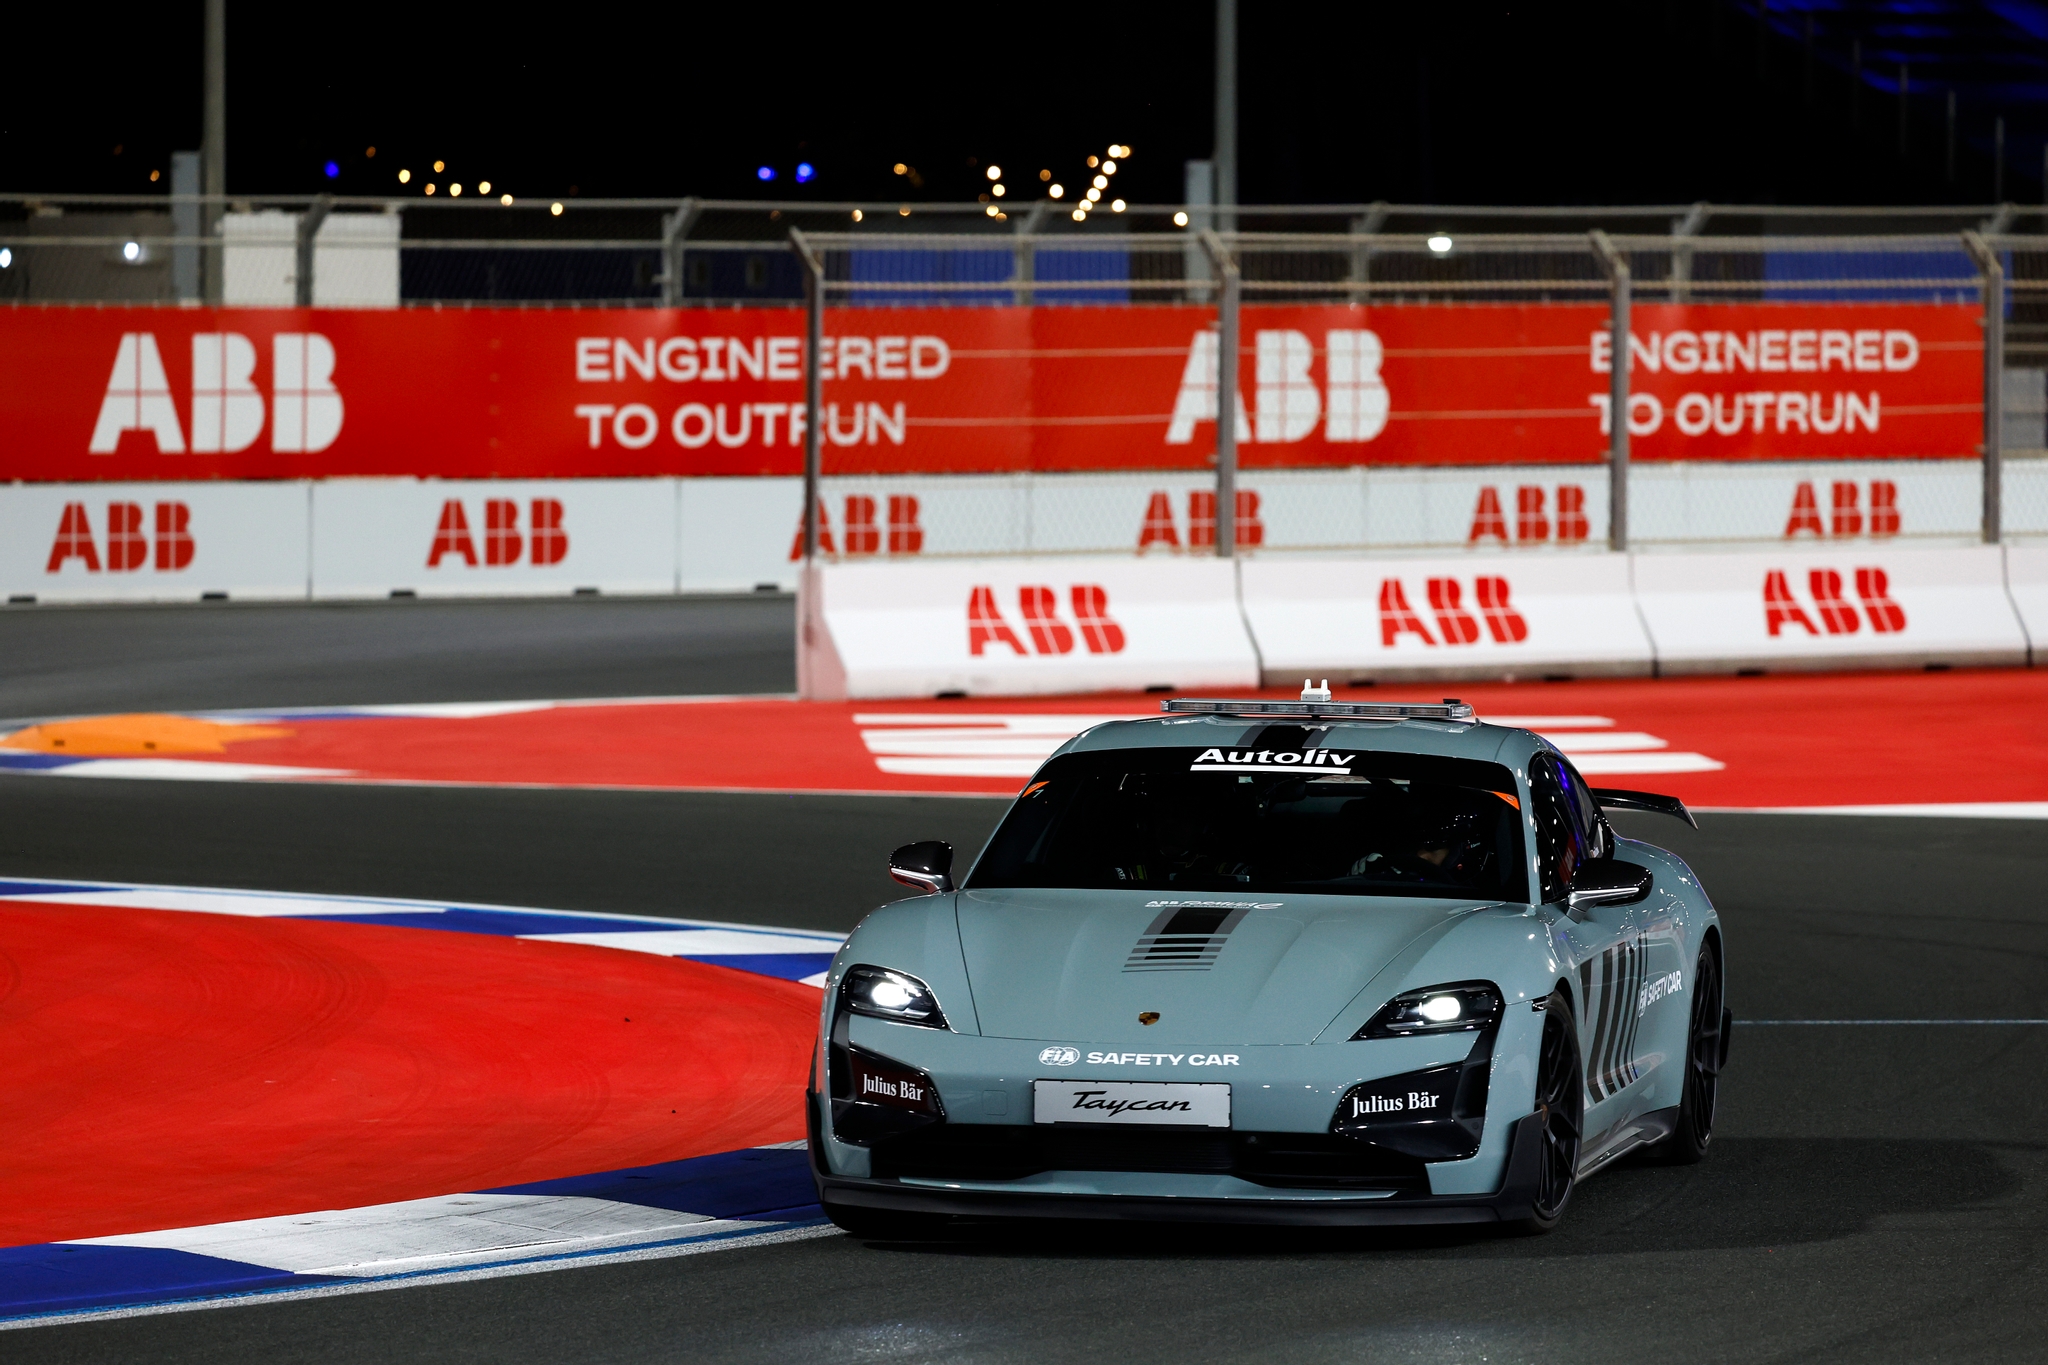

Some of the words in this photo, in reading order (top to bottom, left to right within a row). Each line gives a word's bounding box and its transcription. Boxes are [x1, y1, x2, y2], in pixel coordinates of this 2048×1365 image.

[88, 332, 345, 454] ABB
[1165, 329, 1390, 444] ABB
[1675, 391, 1881, 436] OUTRUN
[574, 402, 659, 448] TO
[46, 501, 196, 573] ABB
[426, 498, 569, 568] ABB
[789, 494, 924, 562] ABB
[1135, 490, 1265, 557] ABB
[1468, 485, 1590, 548] ABB
[1785, 480, 1901, 540] ABB
[967, 585, 1126, 656] ABB
[1378, 576, 1529, 647] ABB
[1763, 566, 1907, 638] ABB
[1193, 748, 1356, 766] Autoliv
[1647, 975, 1669, 1006] SAFETY
[1667, 970, 1682, 995] CAR
[863, 1074, 897, 1097] Julius
[900, 1080, 924, 1101] Bär
[1086, 1052, 1185, 1066] SAFETY
[1188, 1053, 1240, 1066] CAR
[1072, 1090, 1192, 1118] Taycan
[1352, 1095, 1403, 1118] Julius
[1407, 1091, 1440, 1110] Bär
